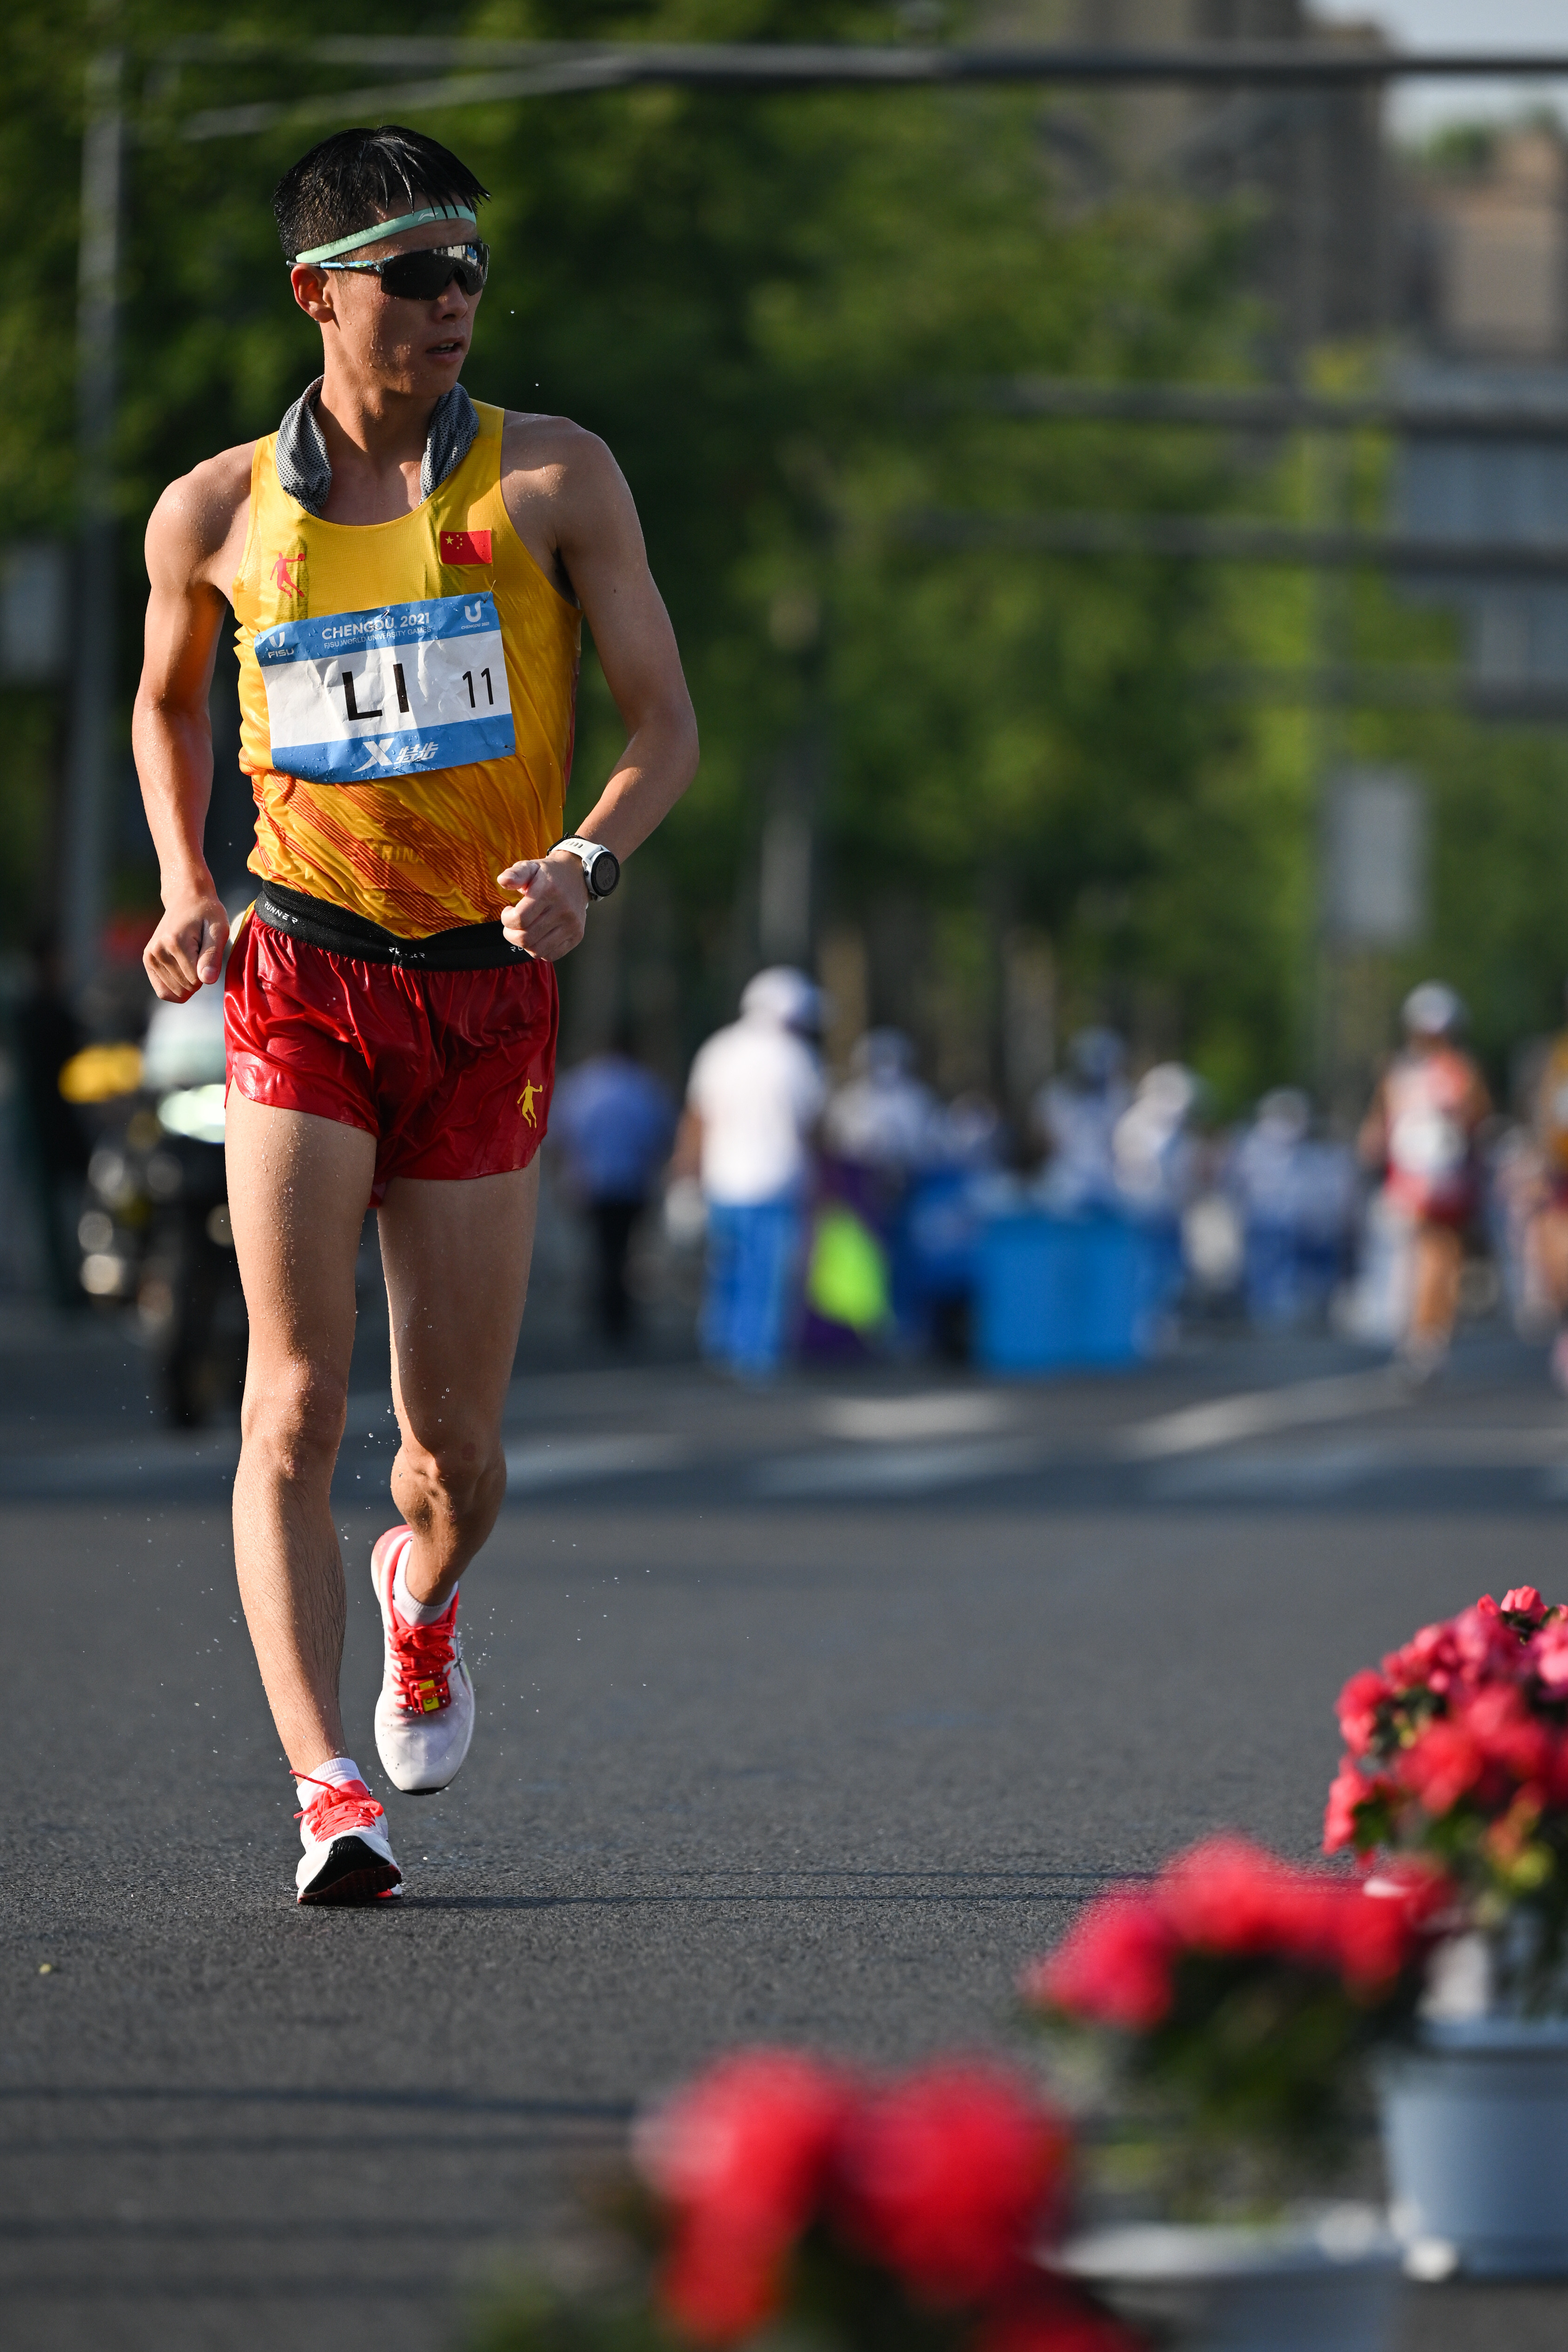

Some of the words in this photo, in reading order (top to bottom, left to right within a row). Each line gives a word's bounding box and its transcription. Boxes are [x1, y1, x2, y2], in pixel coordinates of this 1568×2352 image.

[322, 617, 394, 640] CHENGDU
[400, 612, 430, 628] 2021
[341, 636, 366, 645] WORLD
[367, 630, 406, 642] UNIVERSITY
[407, 626, 431, 635] GAMES
[268, 648, 294, 659] FISU
[342, 663, 410, 721] LI
[462, 667, 494, 708] 11
[264, 901, 298, 924] RUNNER
